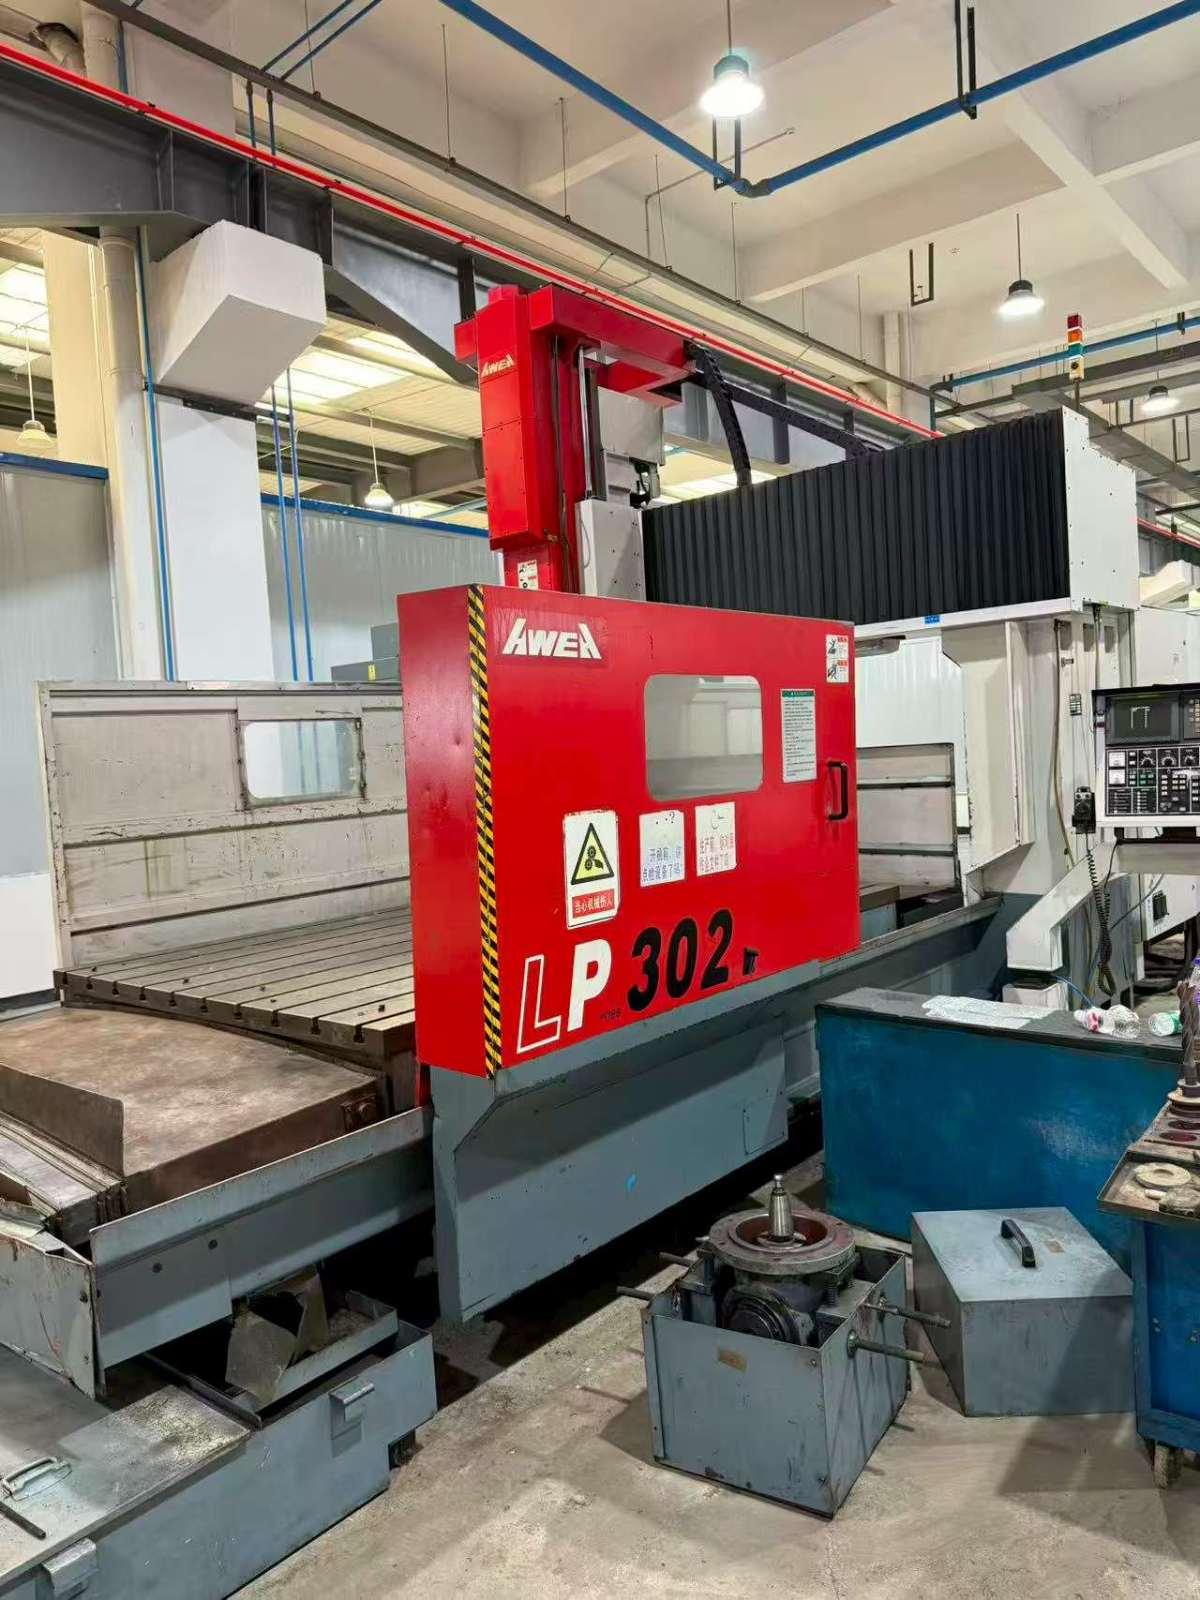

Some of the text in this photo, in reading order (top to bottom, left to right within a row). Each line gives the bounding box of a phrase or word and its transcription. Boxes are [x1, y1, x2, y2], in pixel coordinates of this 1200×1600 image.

[480, 353, 515, 378] AWEA
[502, 617, 602, 659] AWEA
[517, 908, 733, 1054] LP 302
